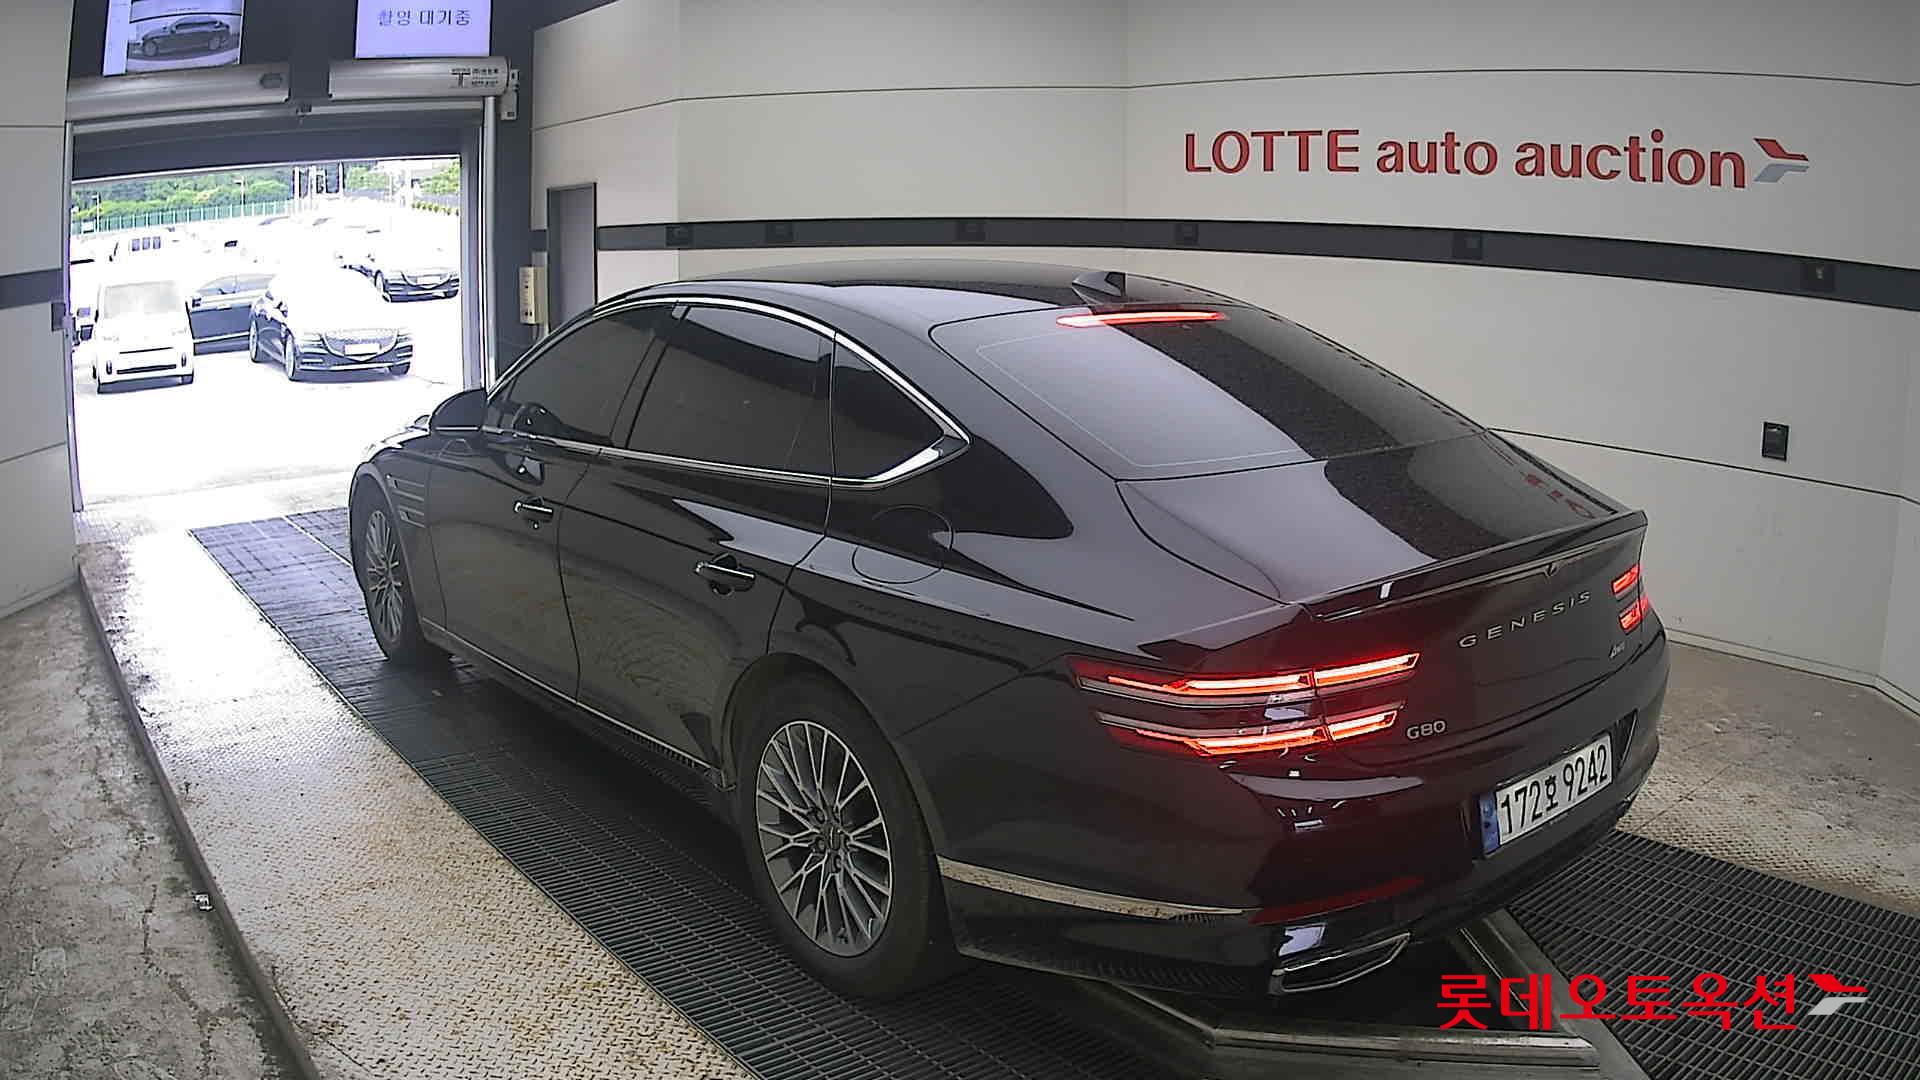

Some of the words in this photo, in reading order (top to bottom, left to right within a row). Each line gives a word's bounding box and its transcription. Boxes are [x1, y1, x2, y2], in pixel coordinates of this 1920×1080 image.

[419, 9, 471, 26] 대기중
[1185, 129, 1360, 173] LOTTE
[1376, 131, 1498, 175] auto
[1514, 130, 1746, 188] auction
[1459, 592, 1592, 648] GENESIS
[1406, 720, 1447, 740] G80
[1562, 745, 1608, 802] 9242
